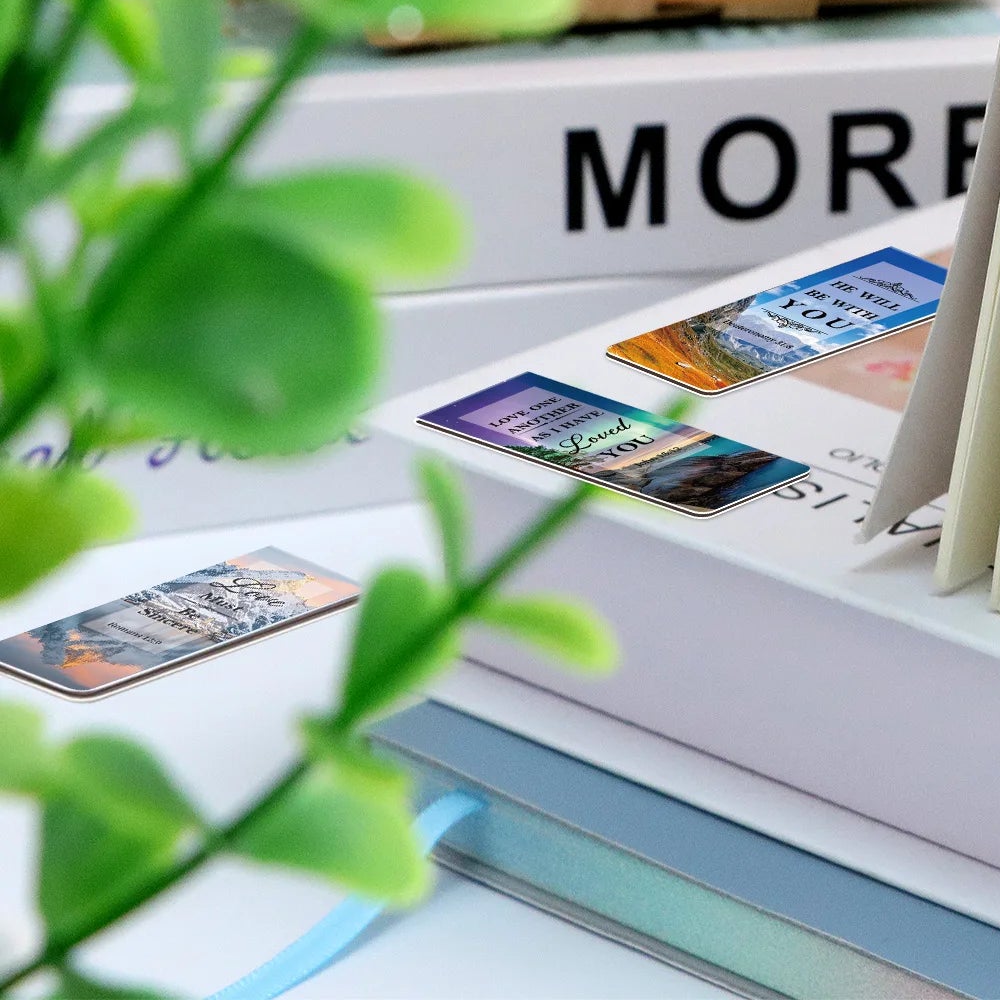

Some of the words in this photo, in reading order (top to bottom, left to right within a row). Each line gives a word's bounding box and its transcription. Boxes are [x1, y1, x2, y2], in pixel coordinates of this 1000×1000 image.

[804, 289, 830, 300] BE
[832, 299, 880, 320] WITH
[829, 281, 858, 293] HE
[860, 291, 902, 312] WILL
[779, 298, 857, 329] YOU
[488, 410, 530, 428] LOVE
[529, 396, 562, 412] ONE
[508, 401, 583, 434] ANOTHER
[531, 432, 551, 442] AS
[550, 424, 562, 434] I
[561, 409, 605, 428] HAVE
[559, 418, 632, 455] Loved
[598, 434, 655, 460] YOU
[200, 592, 244, 612] Must
[209, 577, 286, 607] Love
[137, 607, 199, 635] Sincere
[178, 606, 201, 619] Be
